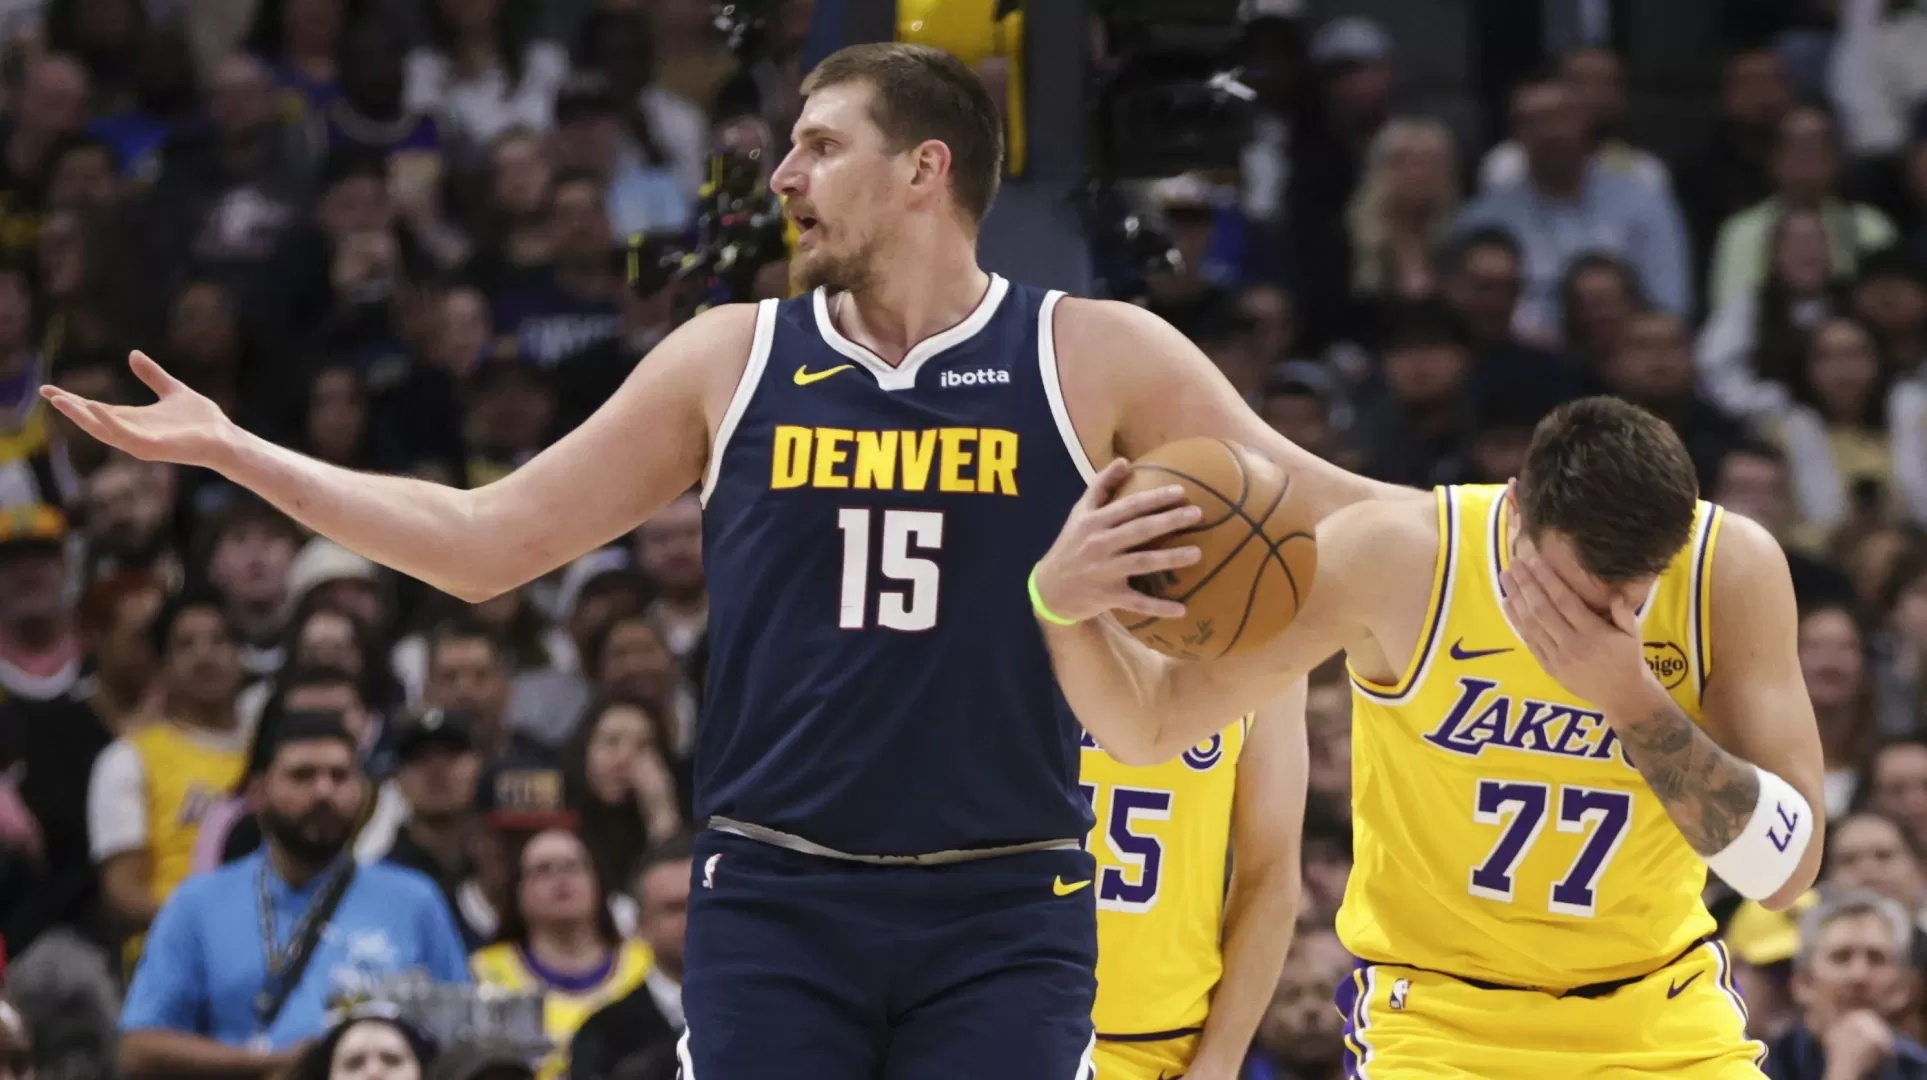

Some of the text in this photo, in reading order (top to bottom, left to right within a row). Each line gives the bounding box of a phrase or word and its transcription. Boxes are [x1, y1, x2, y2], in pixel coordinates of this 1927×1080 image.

[940, 368, 1010, 388] ibotta
[770, 424, 1020, 497] DENVER
[838, 507, 944, 631] 15
[1421, 675, 1640, 770] LAKE
[1468, 778, 1634, 918] 77
[1764, 800, 1798, 853] 77
